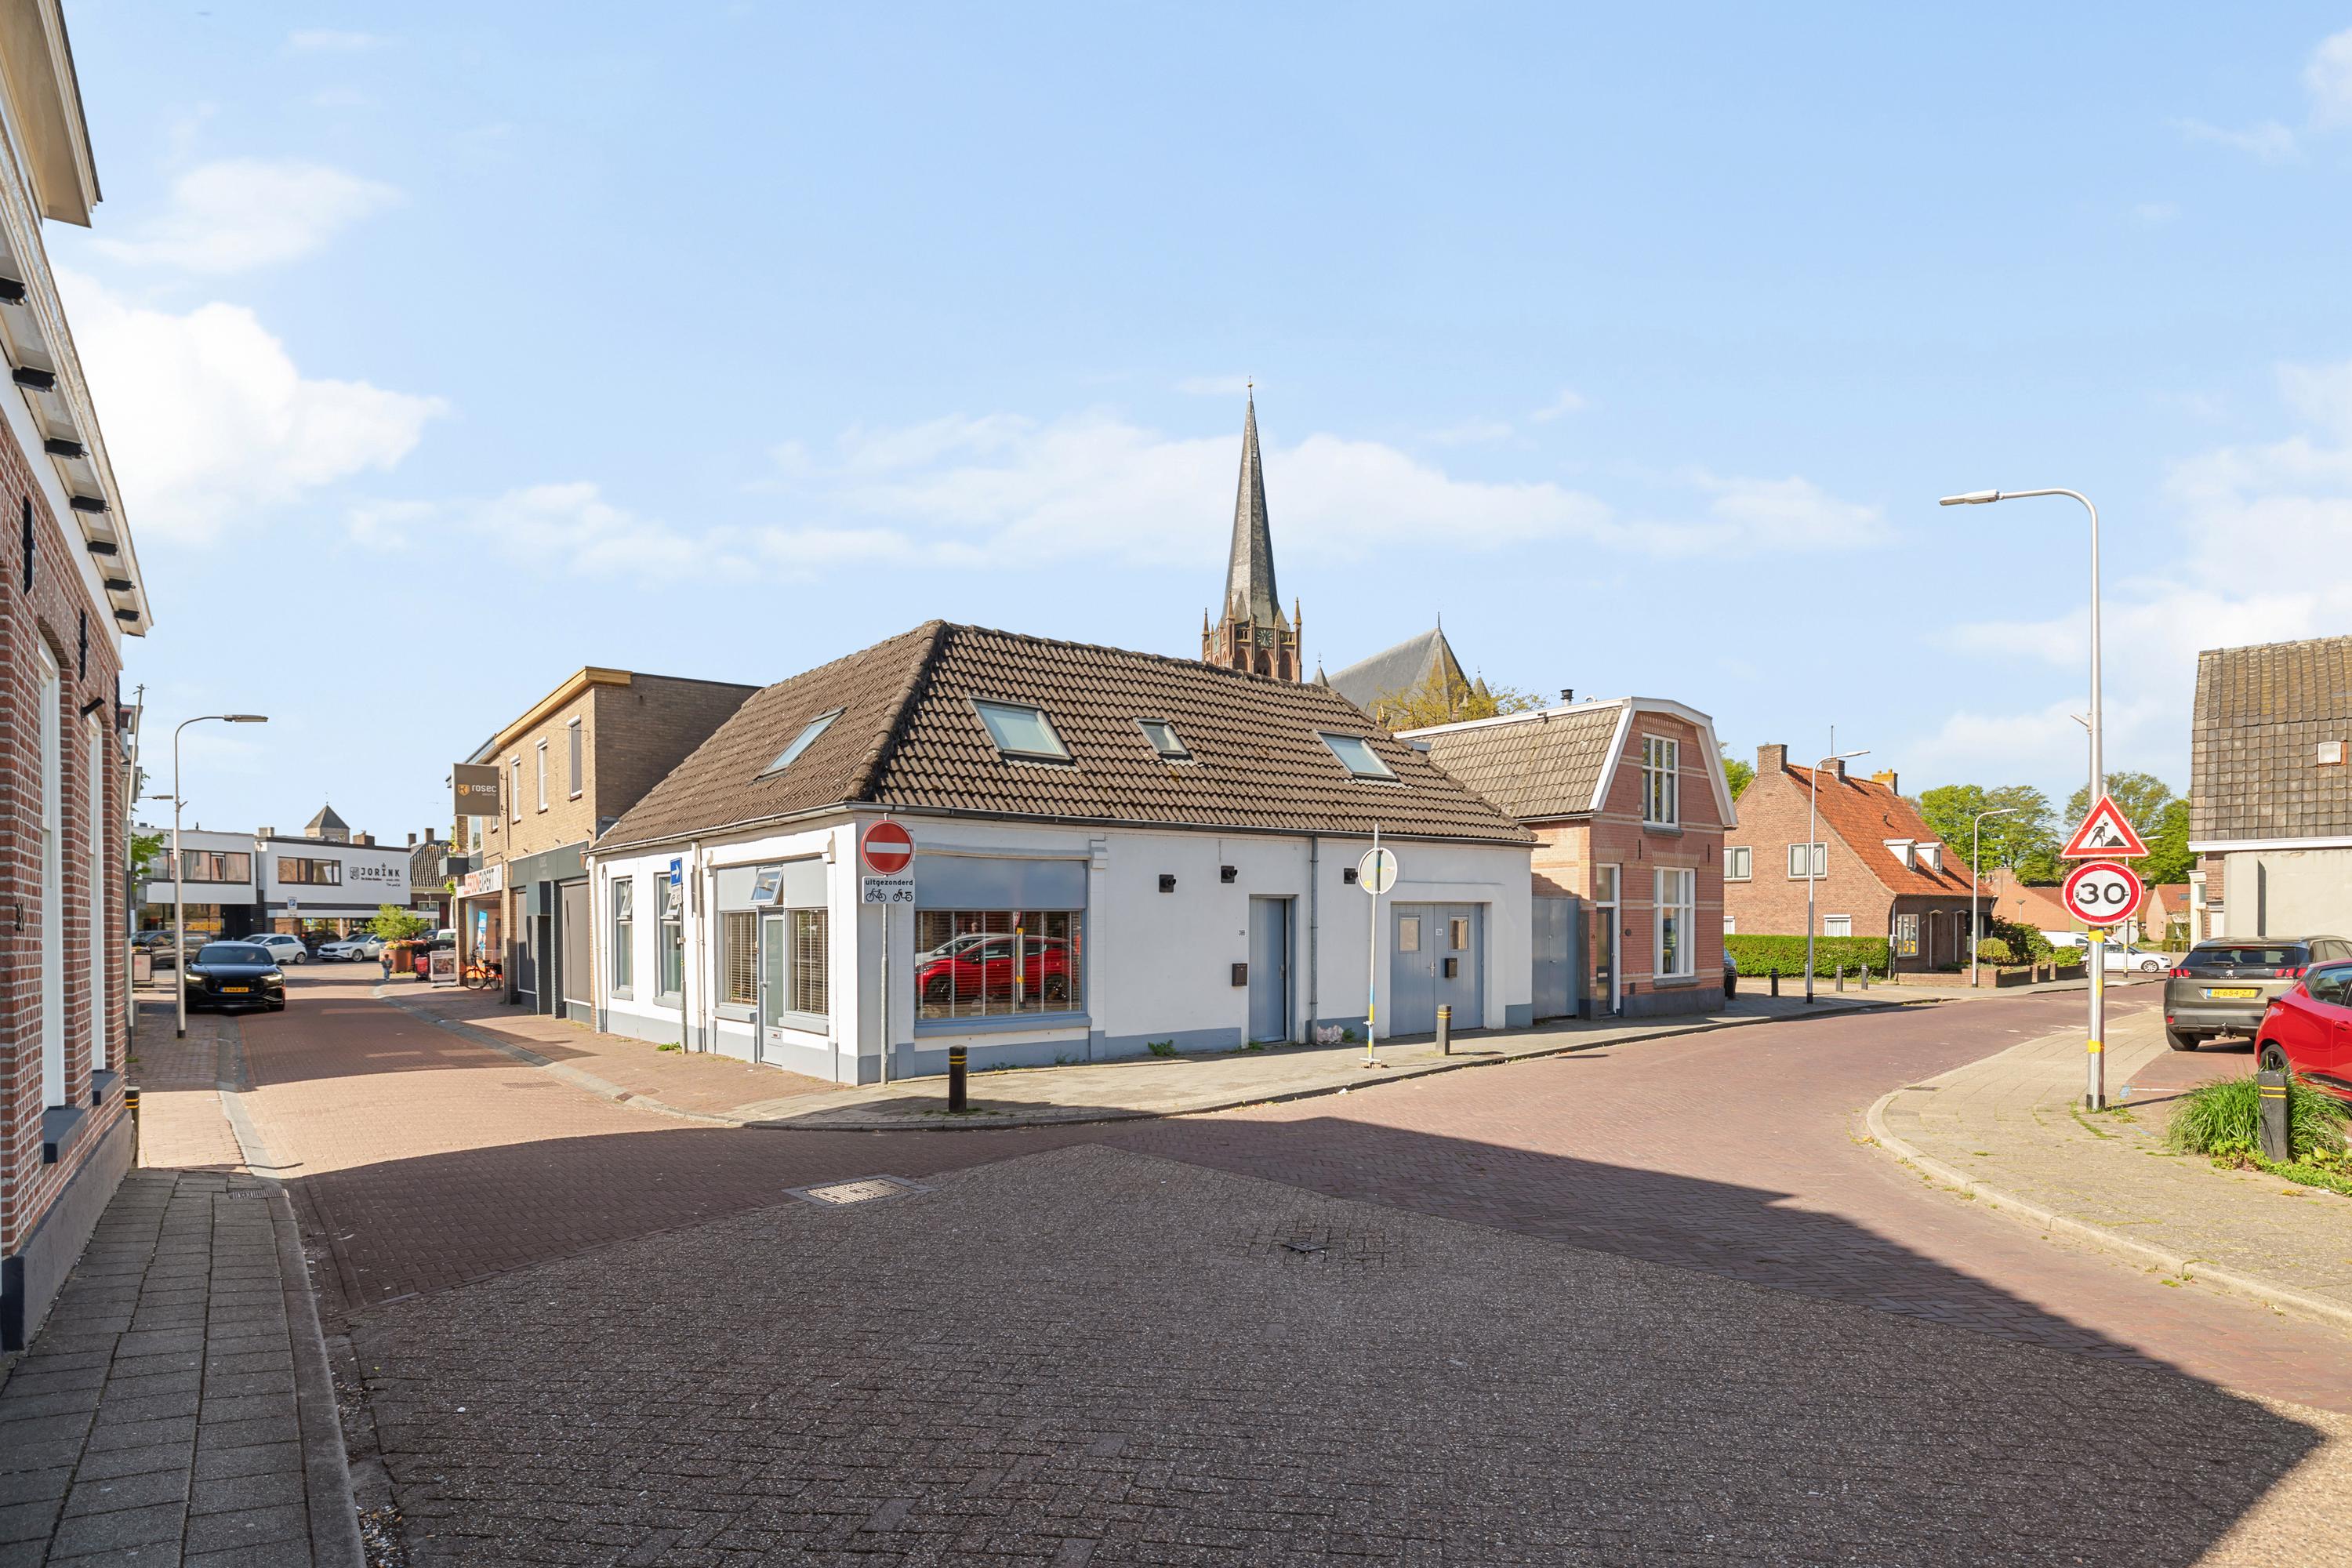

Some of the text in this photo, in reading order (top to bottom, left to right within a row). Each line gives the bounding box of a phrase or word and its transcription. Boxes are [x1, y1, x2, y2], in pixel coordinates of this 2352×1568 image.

[471, 784, 497, 793] rosec
[361, 867, 401, 877] JORINK
[2078, 882, 2126, 905] 30
